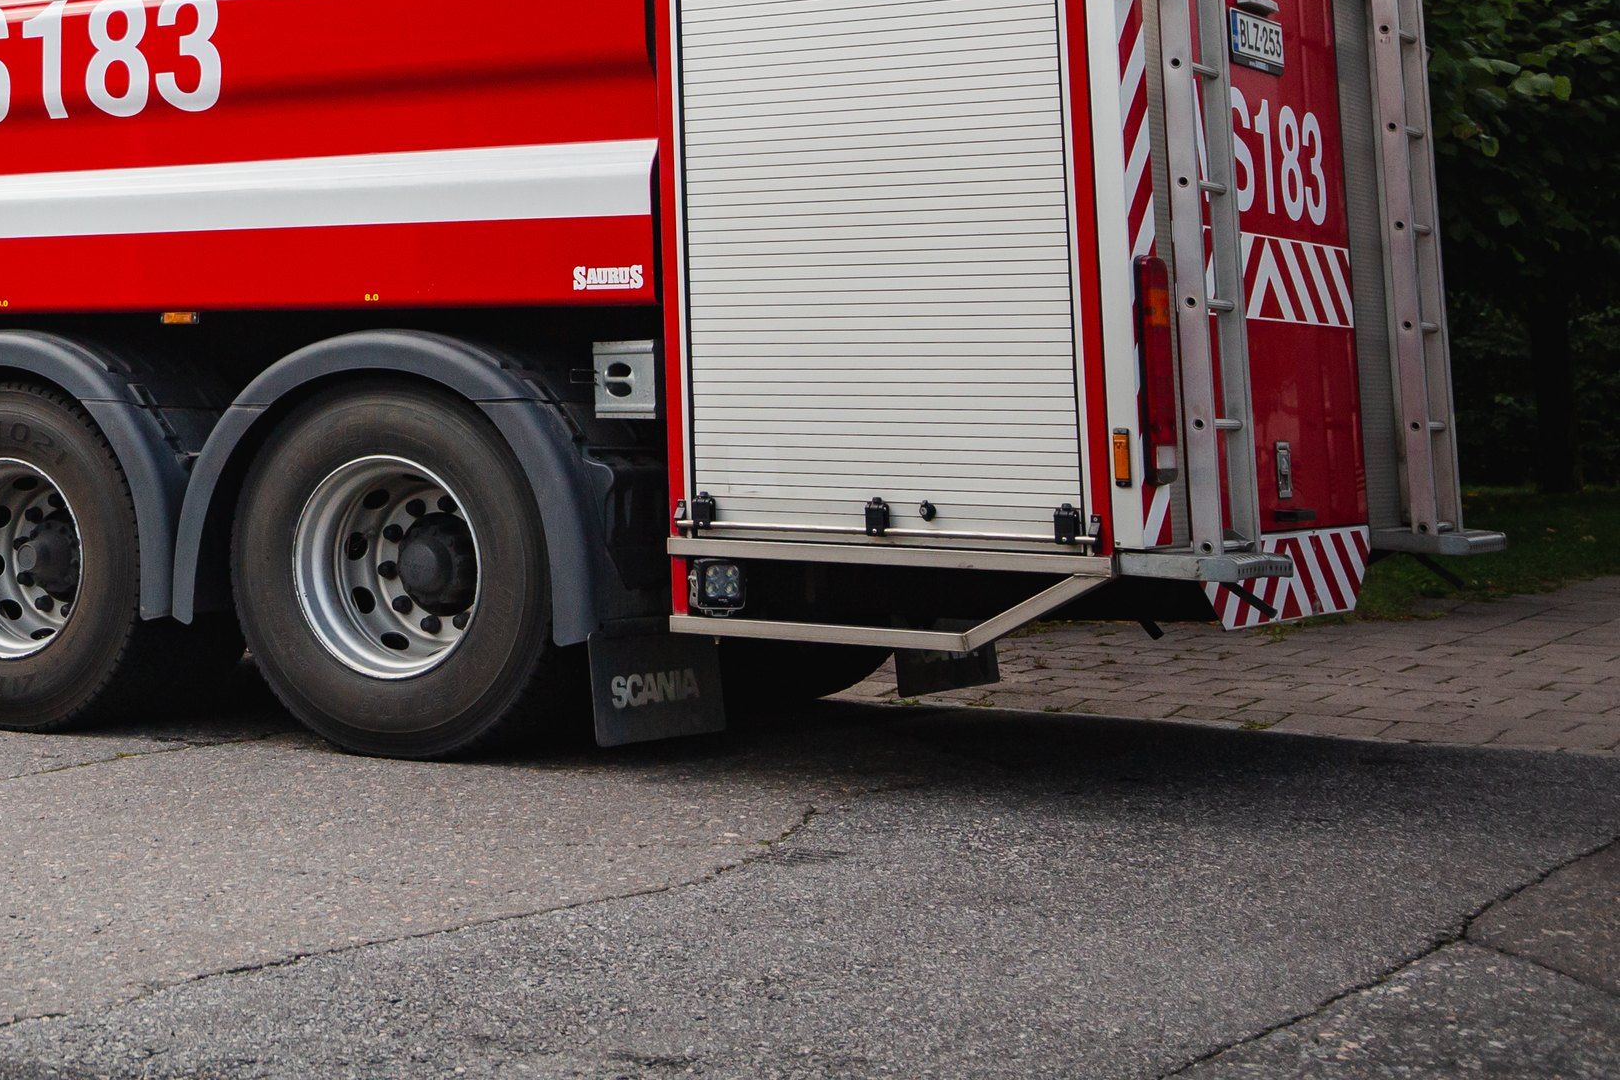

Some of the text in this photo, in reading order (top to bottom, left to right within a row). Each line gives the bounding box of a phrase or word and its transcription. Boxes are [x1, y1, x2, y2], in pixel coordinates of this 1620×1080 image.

[1239, 18, 1282, 58] BLZ-253
[573, 264, 644, 291] SAURUS
[610, 667, 701, 710] SCANIA
